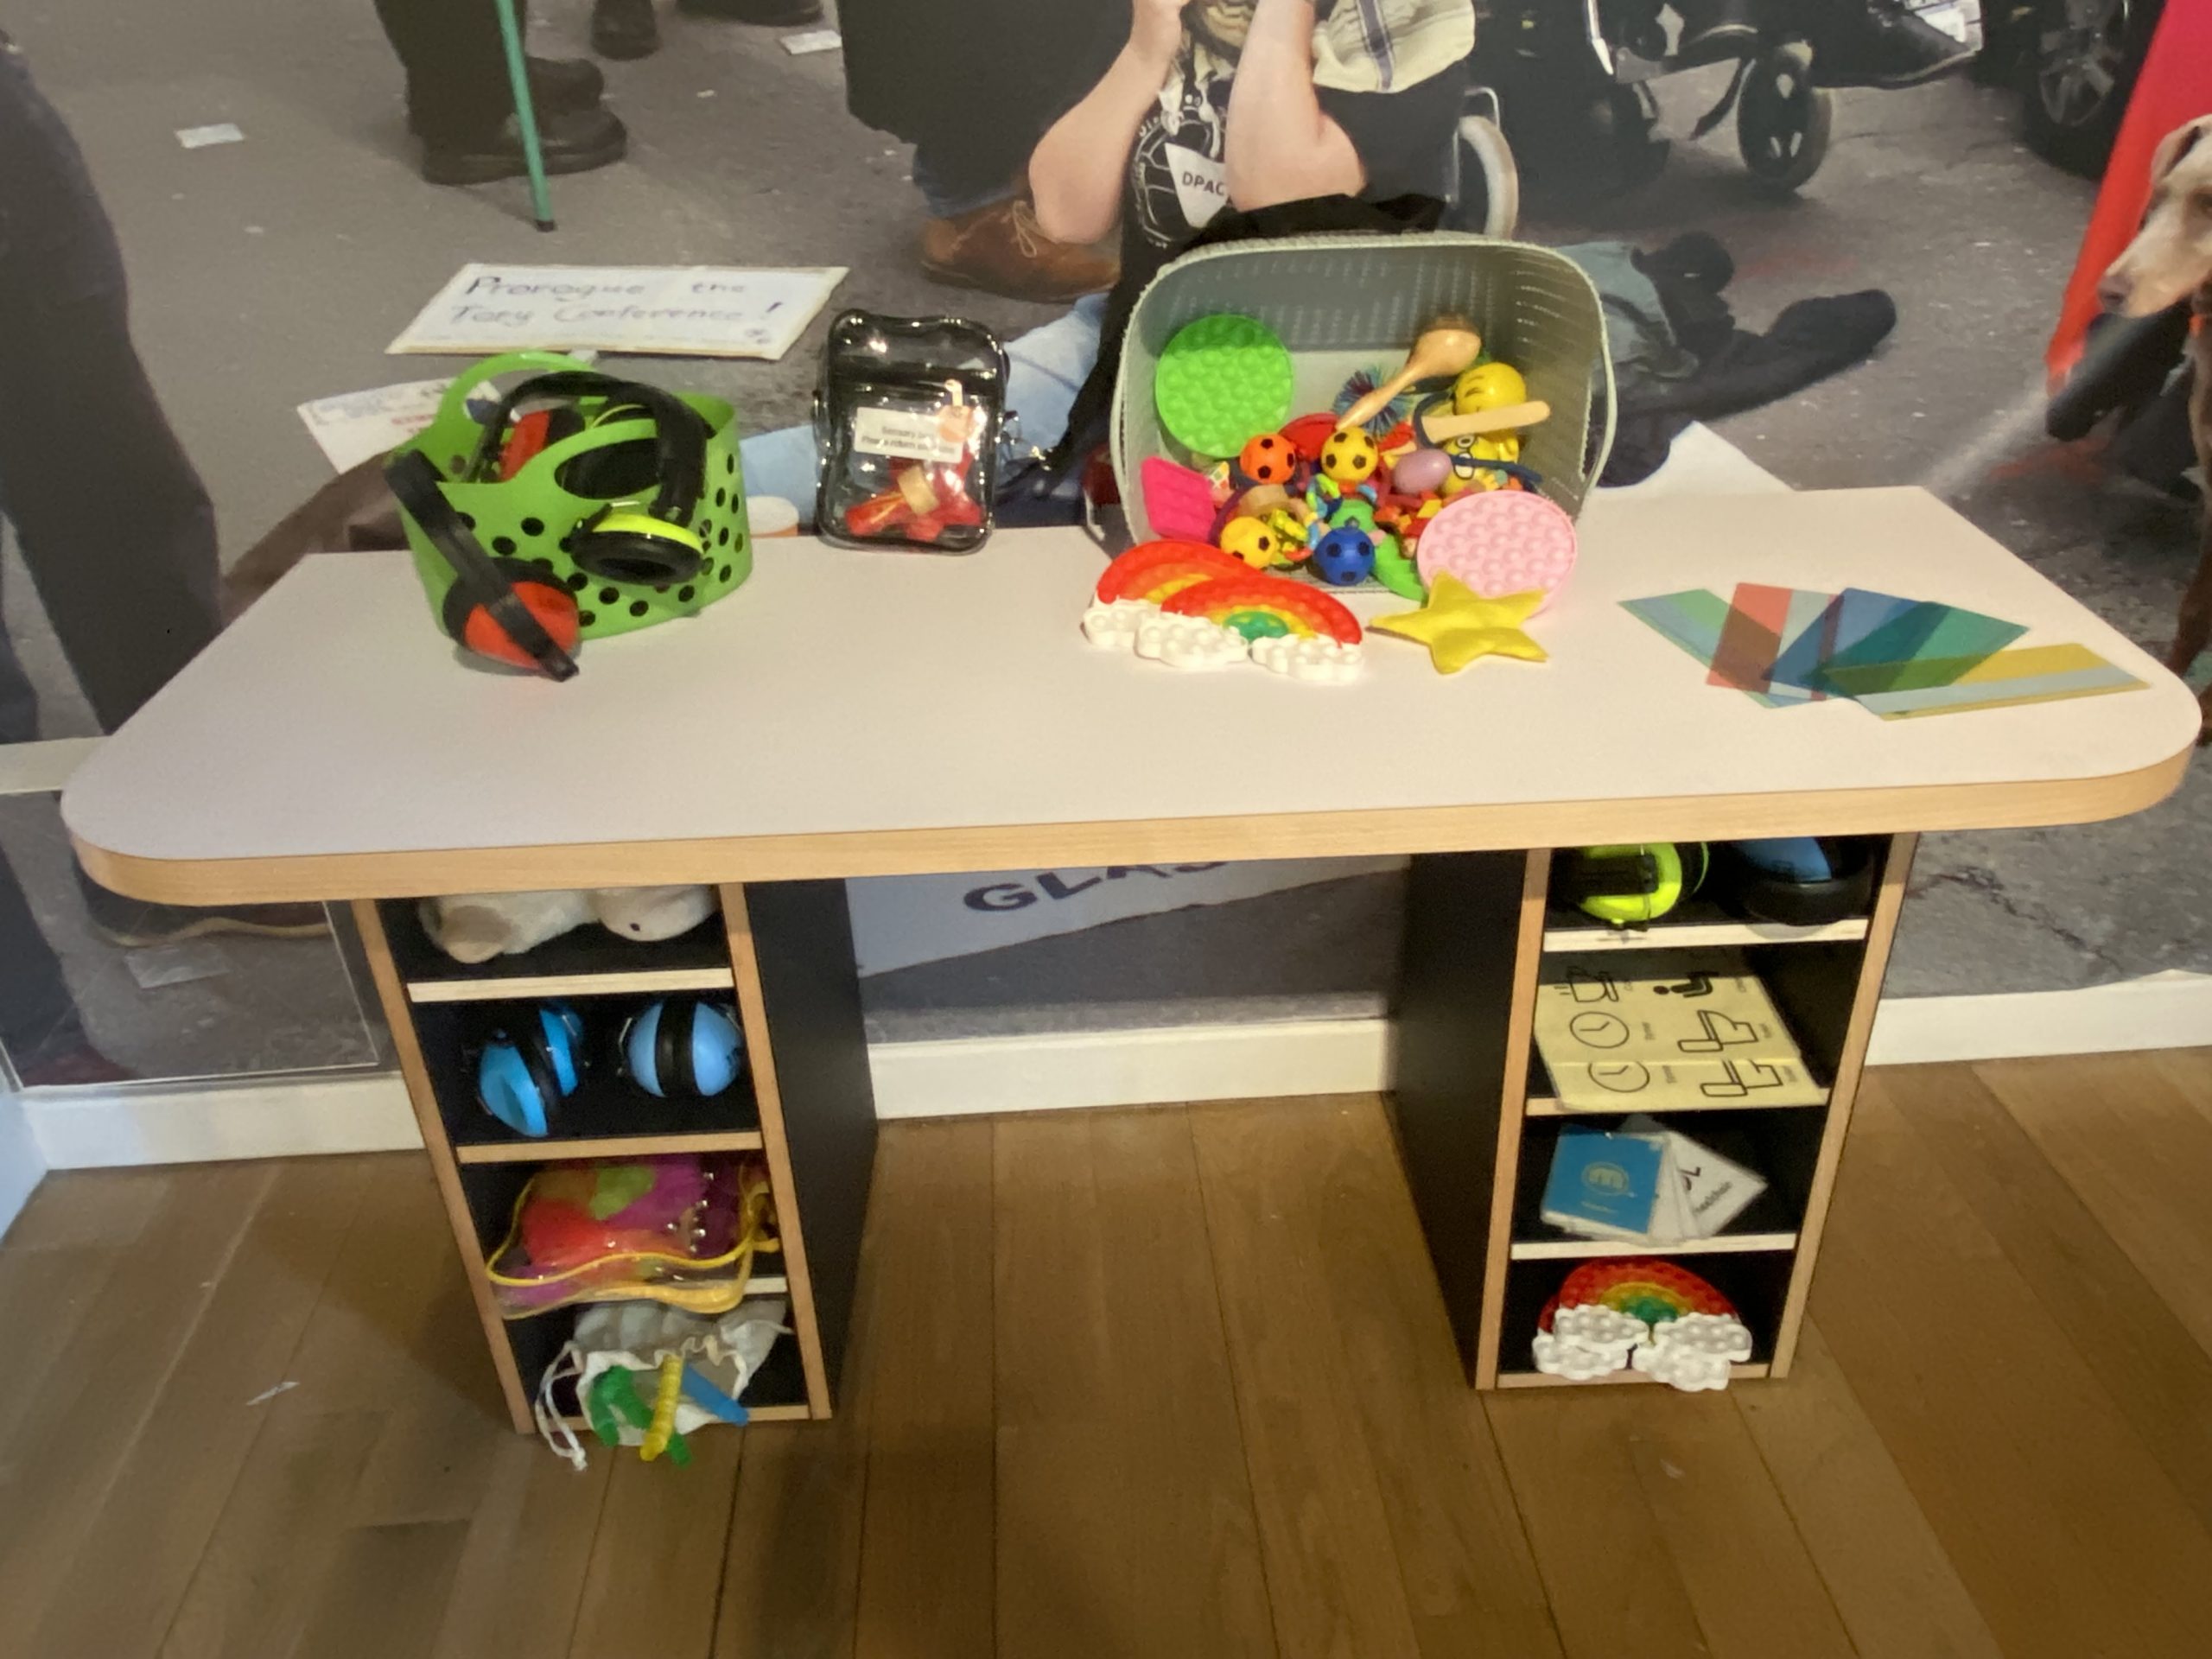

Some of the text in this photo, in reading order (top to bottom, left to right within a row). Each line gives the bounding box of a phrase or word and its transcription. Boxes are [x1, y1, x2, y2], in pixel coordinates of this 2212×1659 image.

[1182, 171, 1225, 195] DPAC
[465, 276, 747, 302] Prorogue the
[450, 305, 534, 327] Tory
